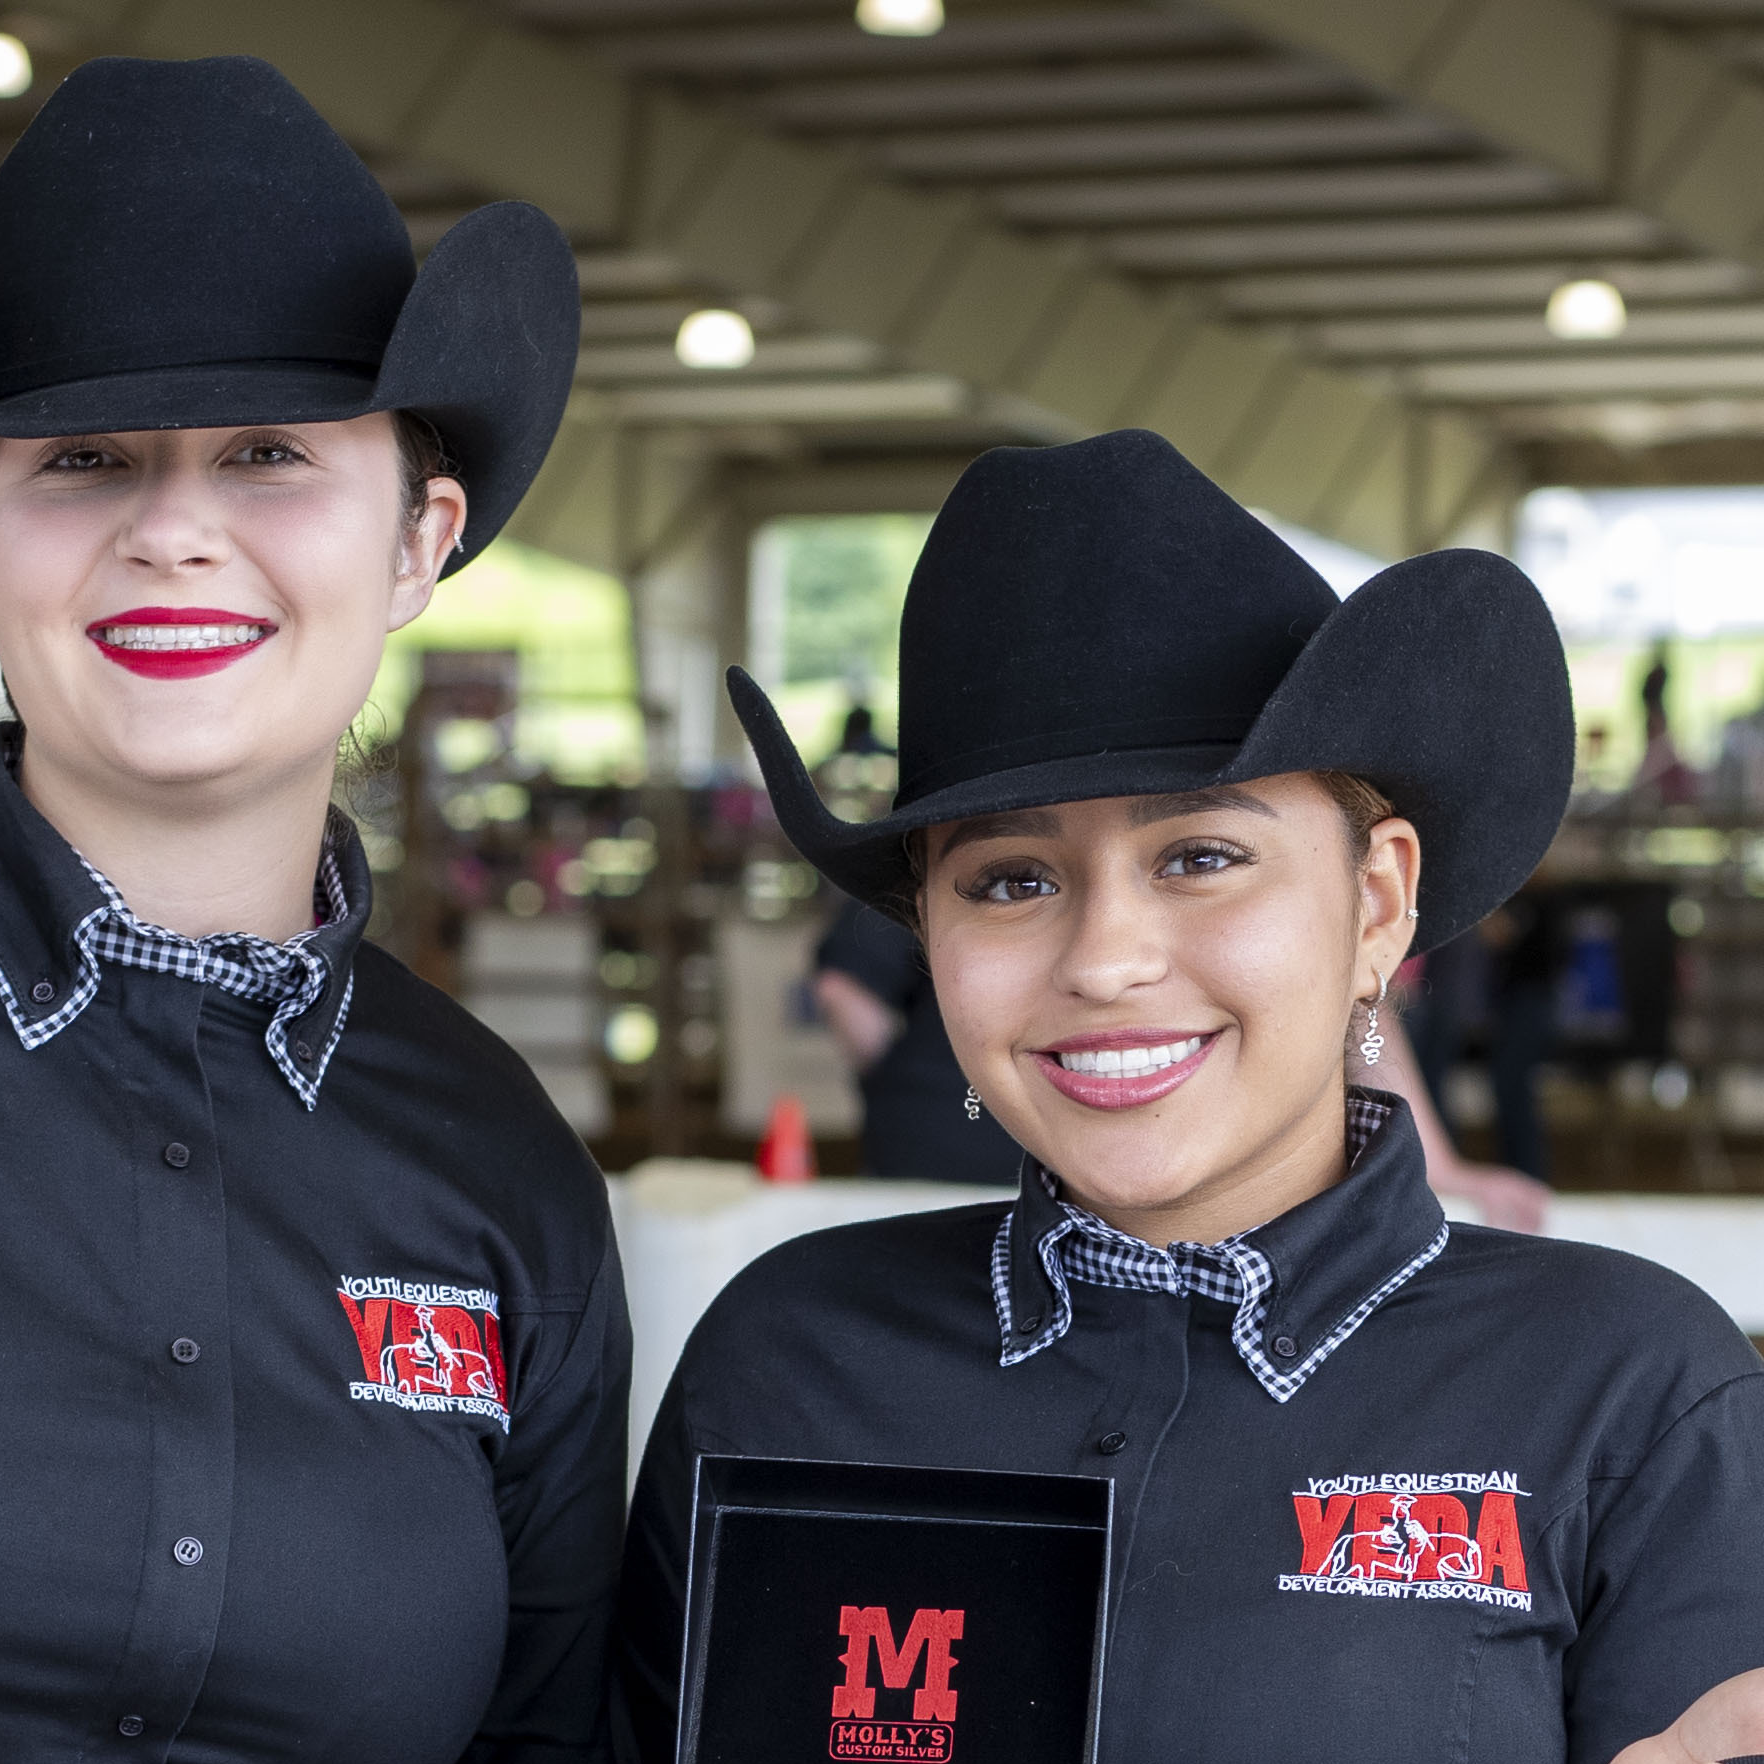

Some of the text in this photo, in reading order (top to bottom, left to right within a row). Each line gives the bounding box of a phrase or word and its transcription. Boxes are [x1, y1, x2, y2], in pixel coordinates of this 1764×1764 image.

[340, 1275, 499, 1315] YOUTH EQUESTRIAN
[350, 1384, 452, 1412] DEVELOPMENT
[1308, 1470, 1518, 1496] YOUTH EQUESTRIAN
[1293, 1491, 1528, 1591] YEDA
[1279, 1576, 1532, 1612] DEVELOPMENT ASSOCIATION
[832, 1605, 965, 1722] M
[837, 1725, 946, 1746] MOLLY'S
[837, 1744, 944, 1758] CUSTOM SILVER
